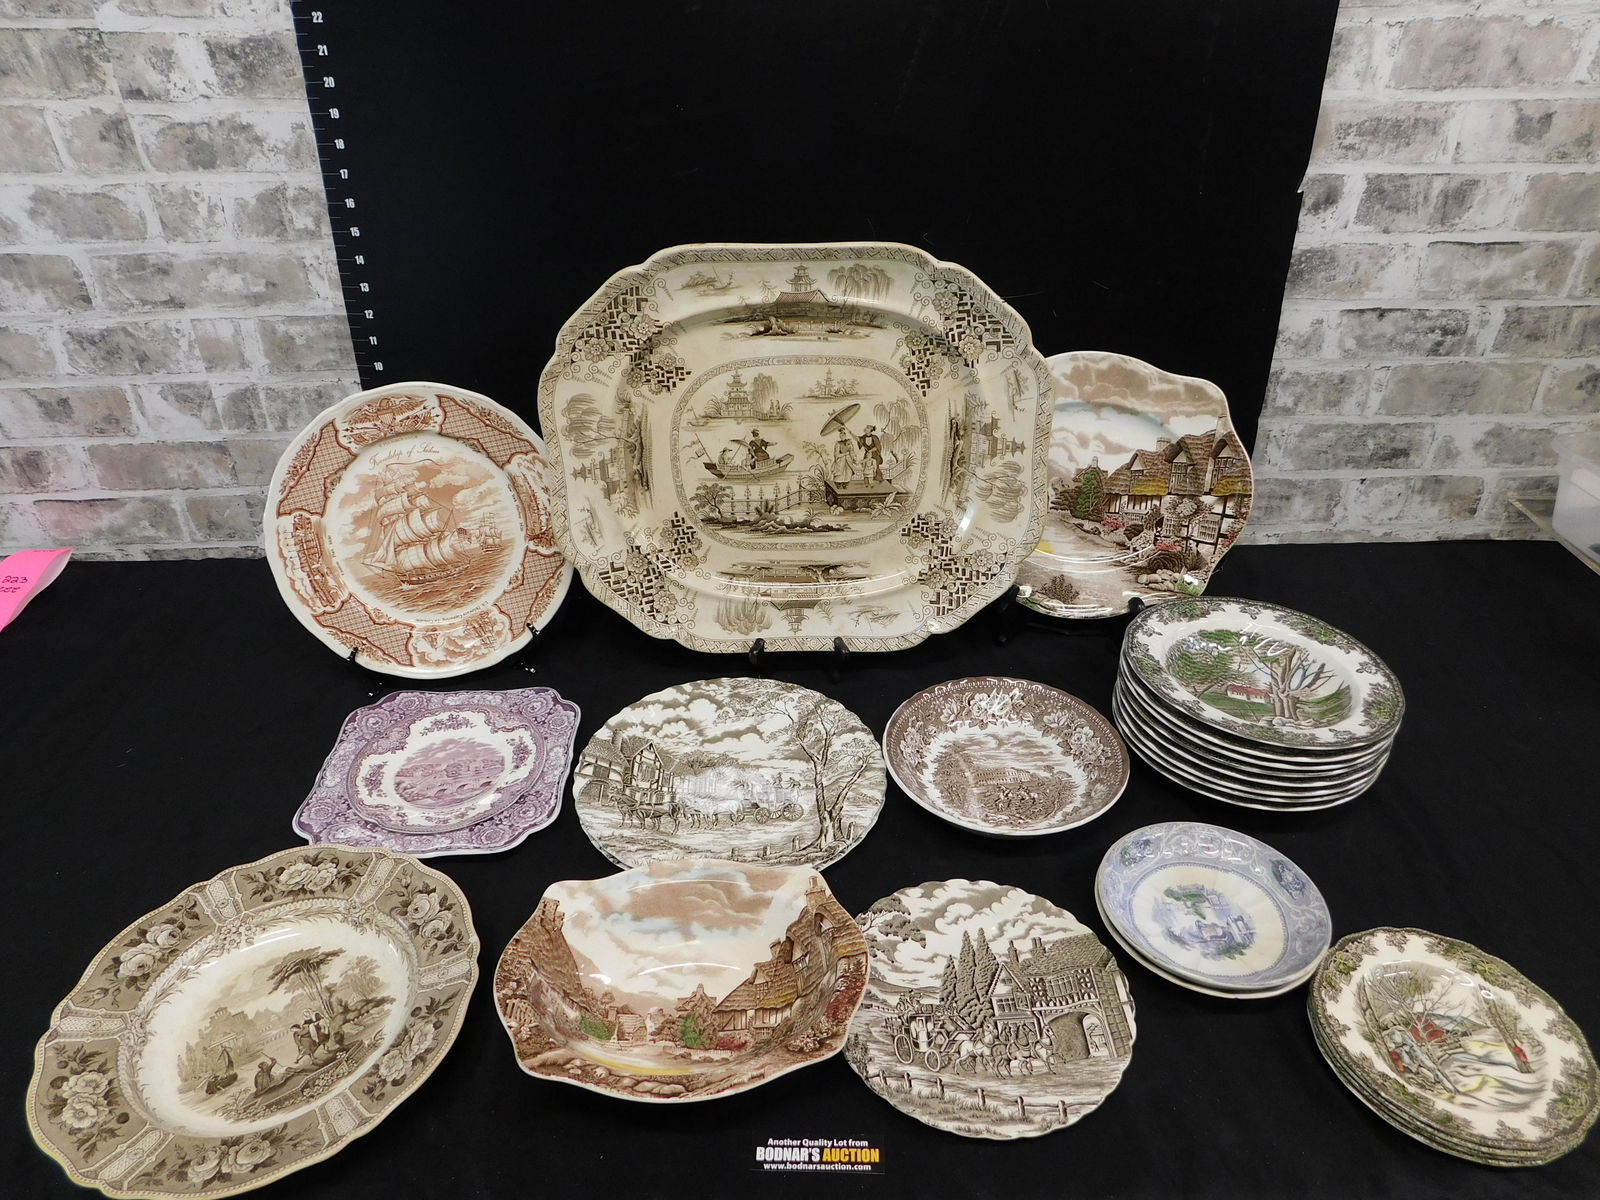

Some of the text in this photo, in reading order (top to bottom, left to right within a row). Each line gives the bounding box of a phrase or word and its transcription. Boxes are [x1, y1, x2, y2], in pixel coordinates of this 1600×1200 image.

[312, 11, 323, 23] 22
[318, 45, 328, 56] 21
[323, 76, 335, 88] 20
[329, 108, 339, 119] 19
[334, 138, 345, 150] 18
[340, 168, 348, 179] 17
[345, 198, 355, 209] 16
[350, 227, 360, 237] 15
[355, 255, 364, 265] 14
[360, 283, 369, 292] 13
[364, 310, 374, 319] 12
[369, 336, 377, 345] 11
[374, 362, 383, 371] 10
[767, 1138, 869, 1148] Another Quality Lot from
[756, 1146, 880, 1163] BODNAR'S AUCTION
[763, 1162, 872, 1171] www.bodnarsauction.com
